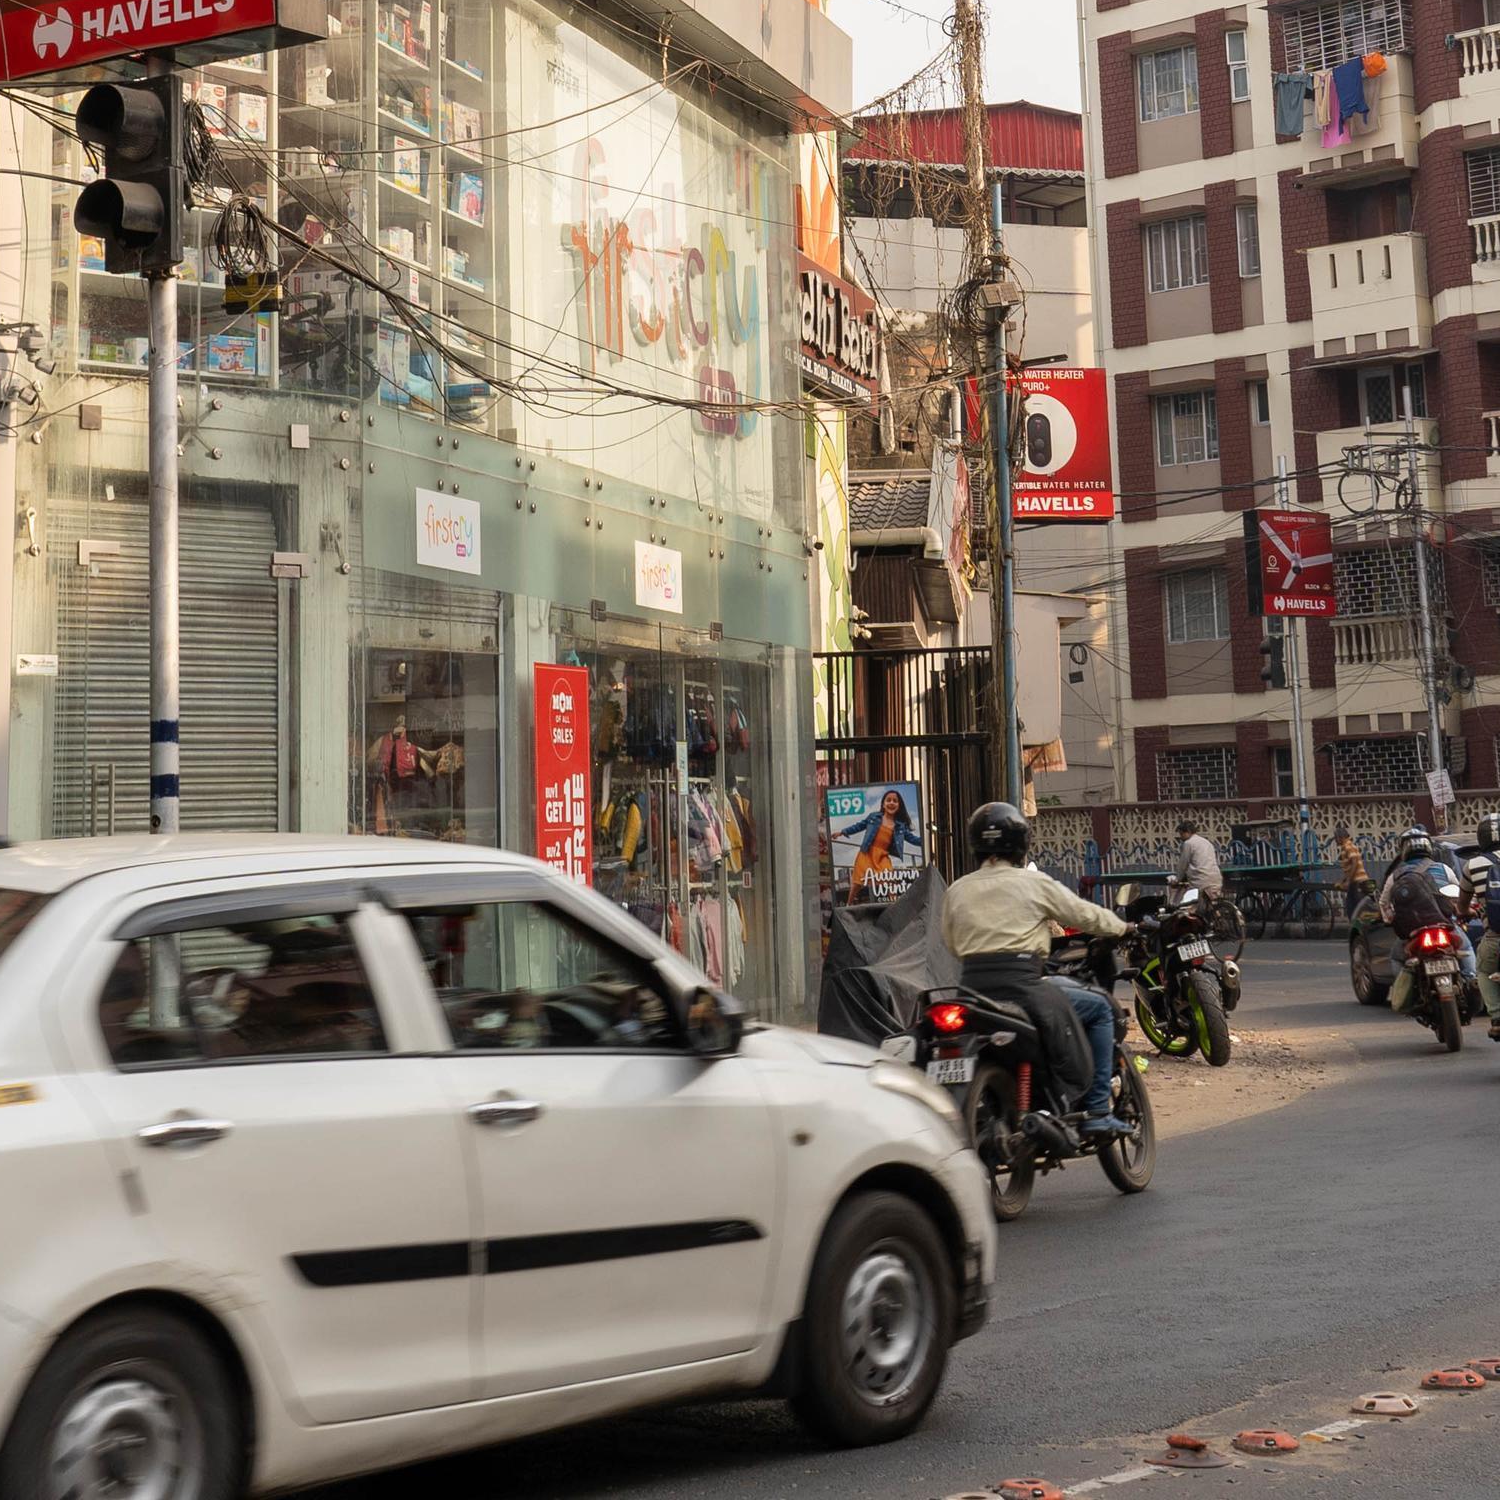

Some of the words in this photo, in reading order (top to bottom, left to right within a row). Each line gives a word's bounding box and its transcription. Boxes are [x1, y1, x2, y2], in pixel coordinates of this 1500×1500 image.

[1024, 370, 1051, 380] WATER
[1053, 370, 1084, 380] HEATER
[1074, 481, 1105, 489] HEATER
[1018, 496, 1094, 511] HAVELLS
[425, 504, 473, 557] firstcry
[642, 554, 676, 599] firstcry
[1286, 599, 1326, 610] HAVELLS
[552, 692, 573, 713] MOM
[555, 715, 562, 723] OF
[553, 727, 574, 744] SALES
[546, 800, 564, 823] GET
[564, 778, 571, 823] 1
[572, 773, 586, 885] FREE
[863, 867, 920, 887] Autumn
[873, 879, 913, 897] Winte
